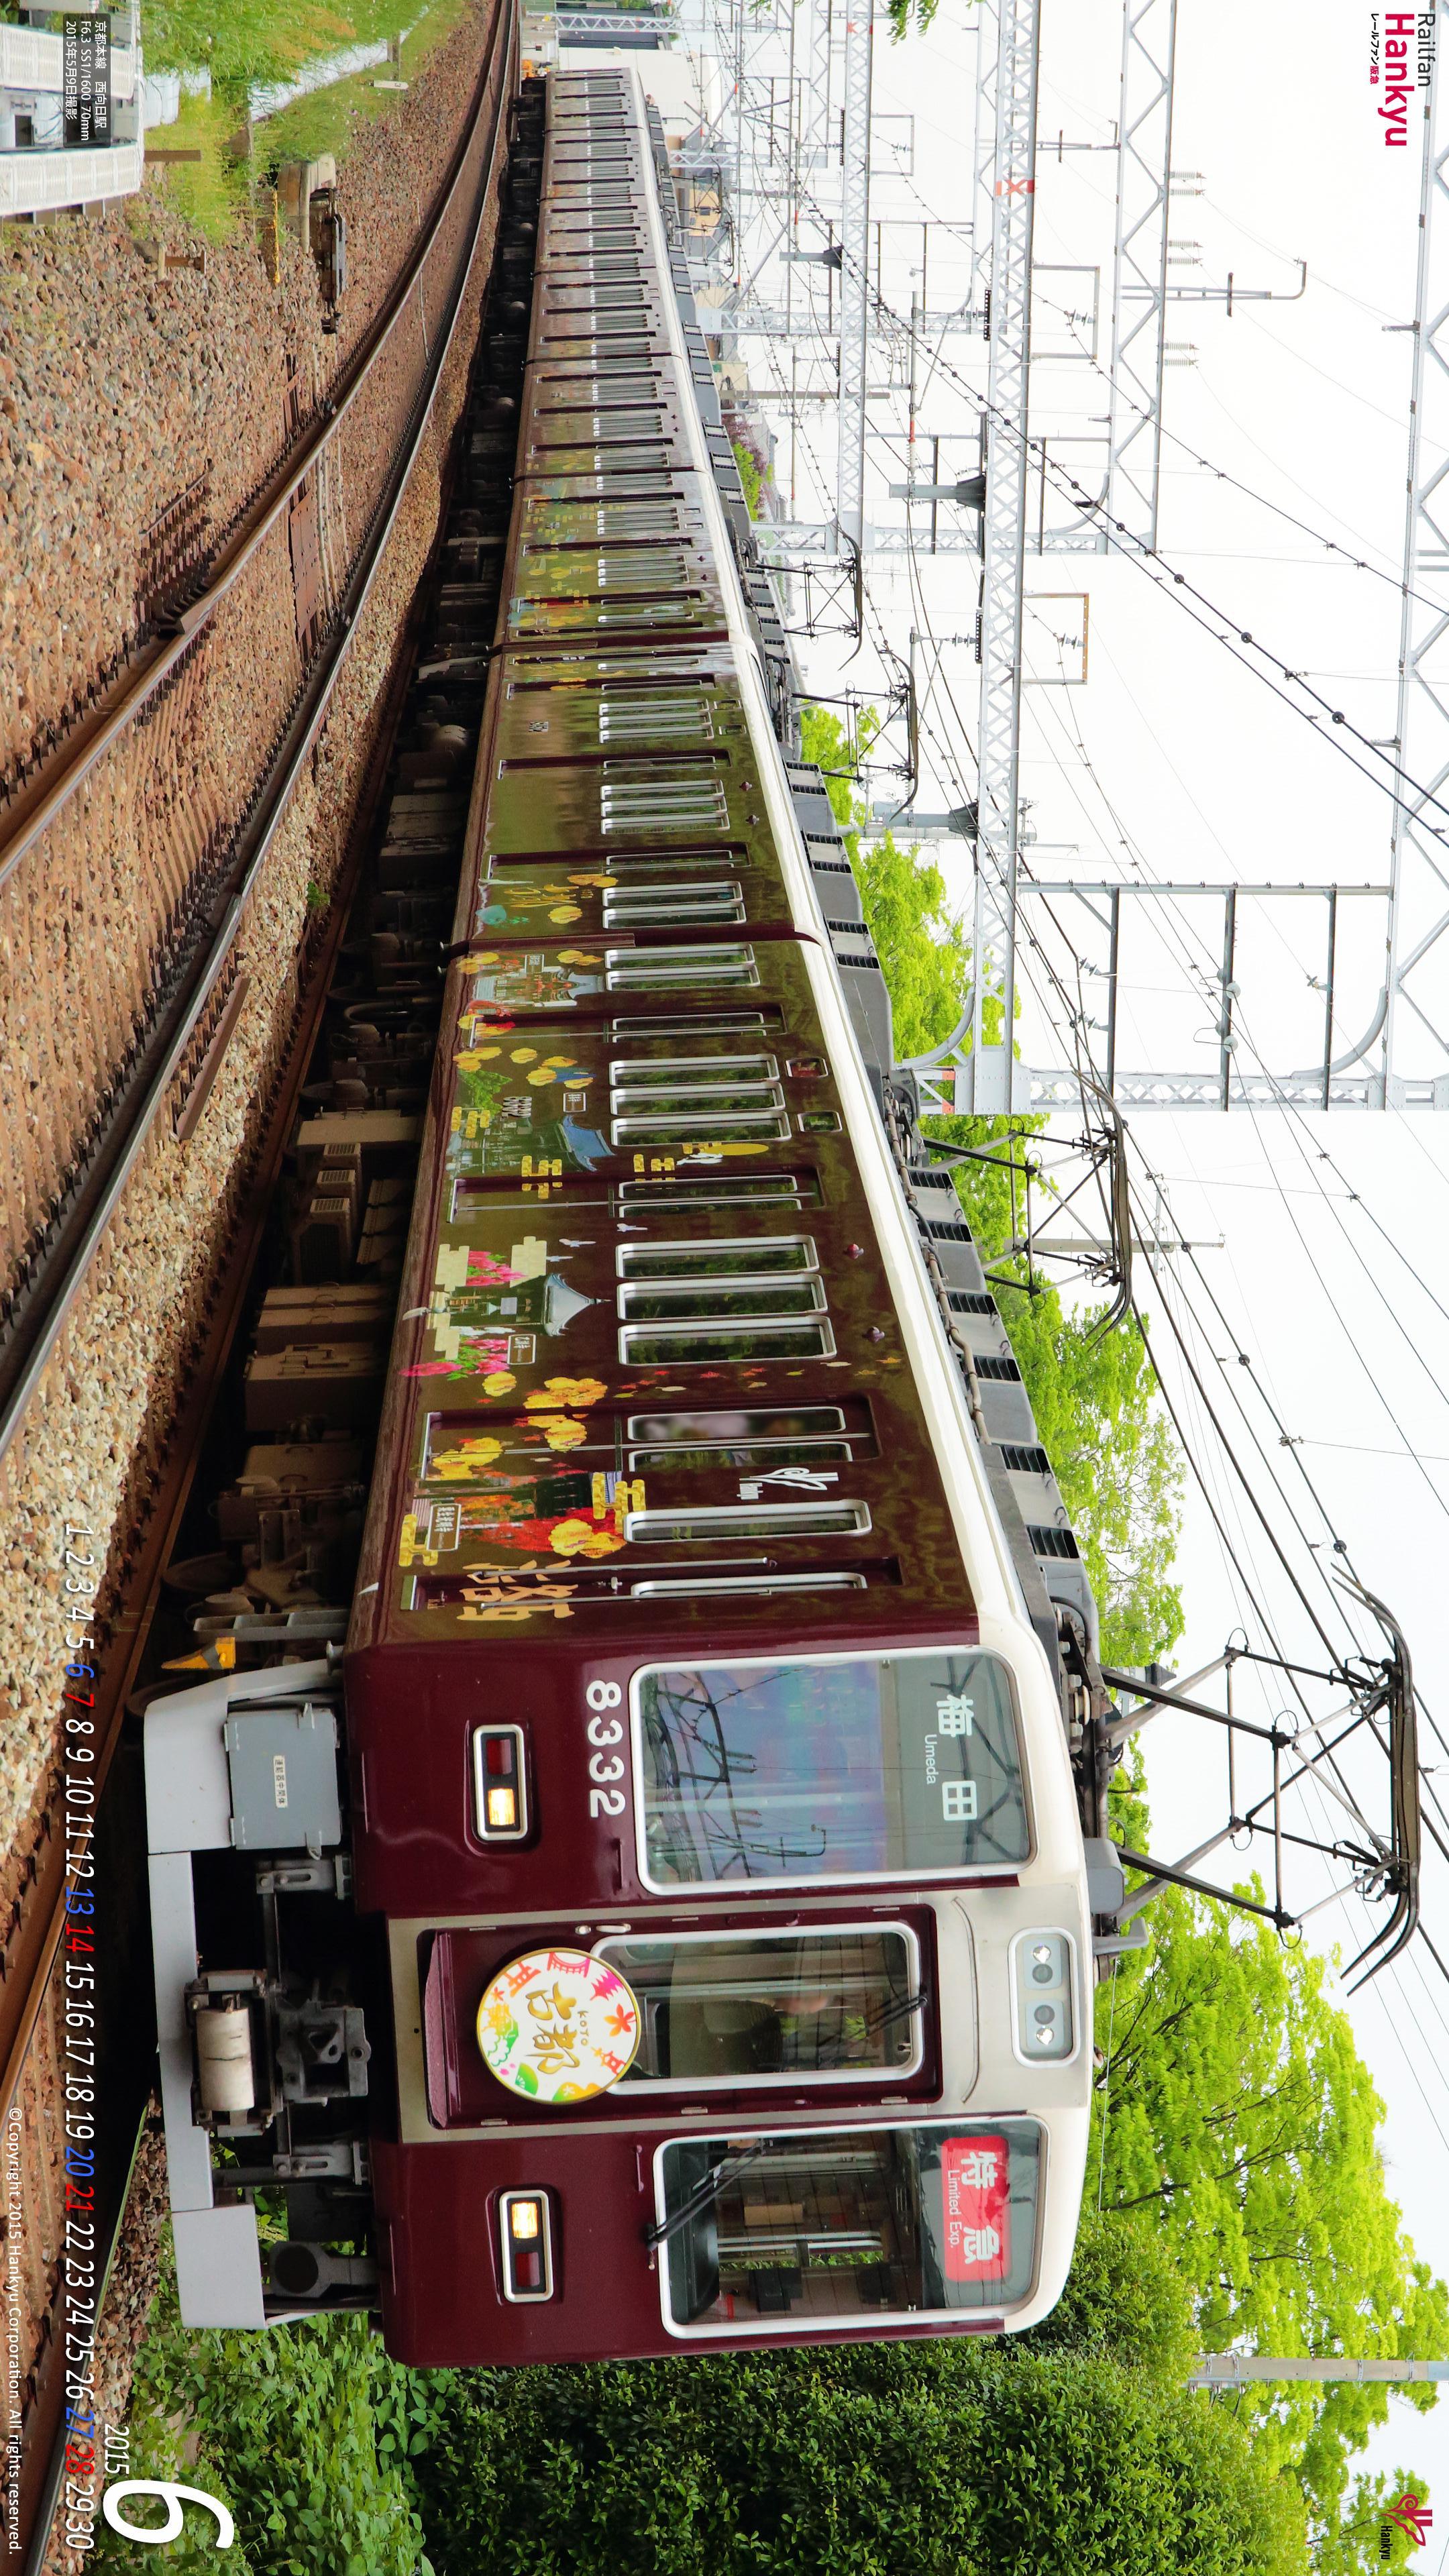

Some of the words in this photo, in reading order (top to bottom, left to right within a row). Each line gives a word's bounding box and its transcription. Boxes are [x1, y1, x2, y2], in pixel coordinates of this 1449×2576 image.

[586, 1680, 626, 1818] 8332
[924, 1734, 938, 1784] Umeda
[936, 1694, 977, 1821] 梅田
[523, 1981, 580, 2075] 古都
[947, 2169, 961, 2215] Limited
[949, 2221, 963, 2248] Exp.
[961, 2151, 1000, 2264] 特急
